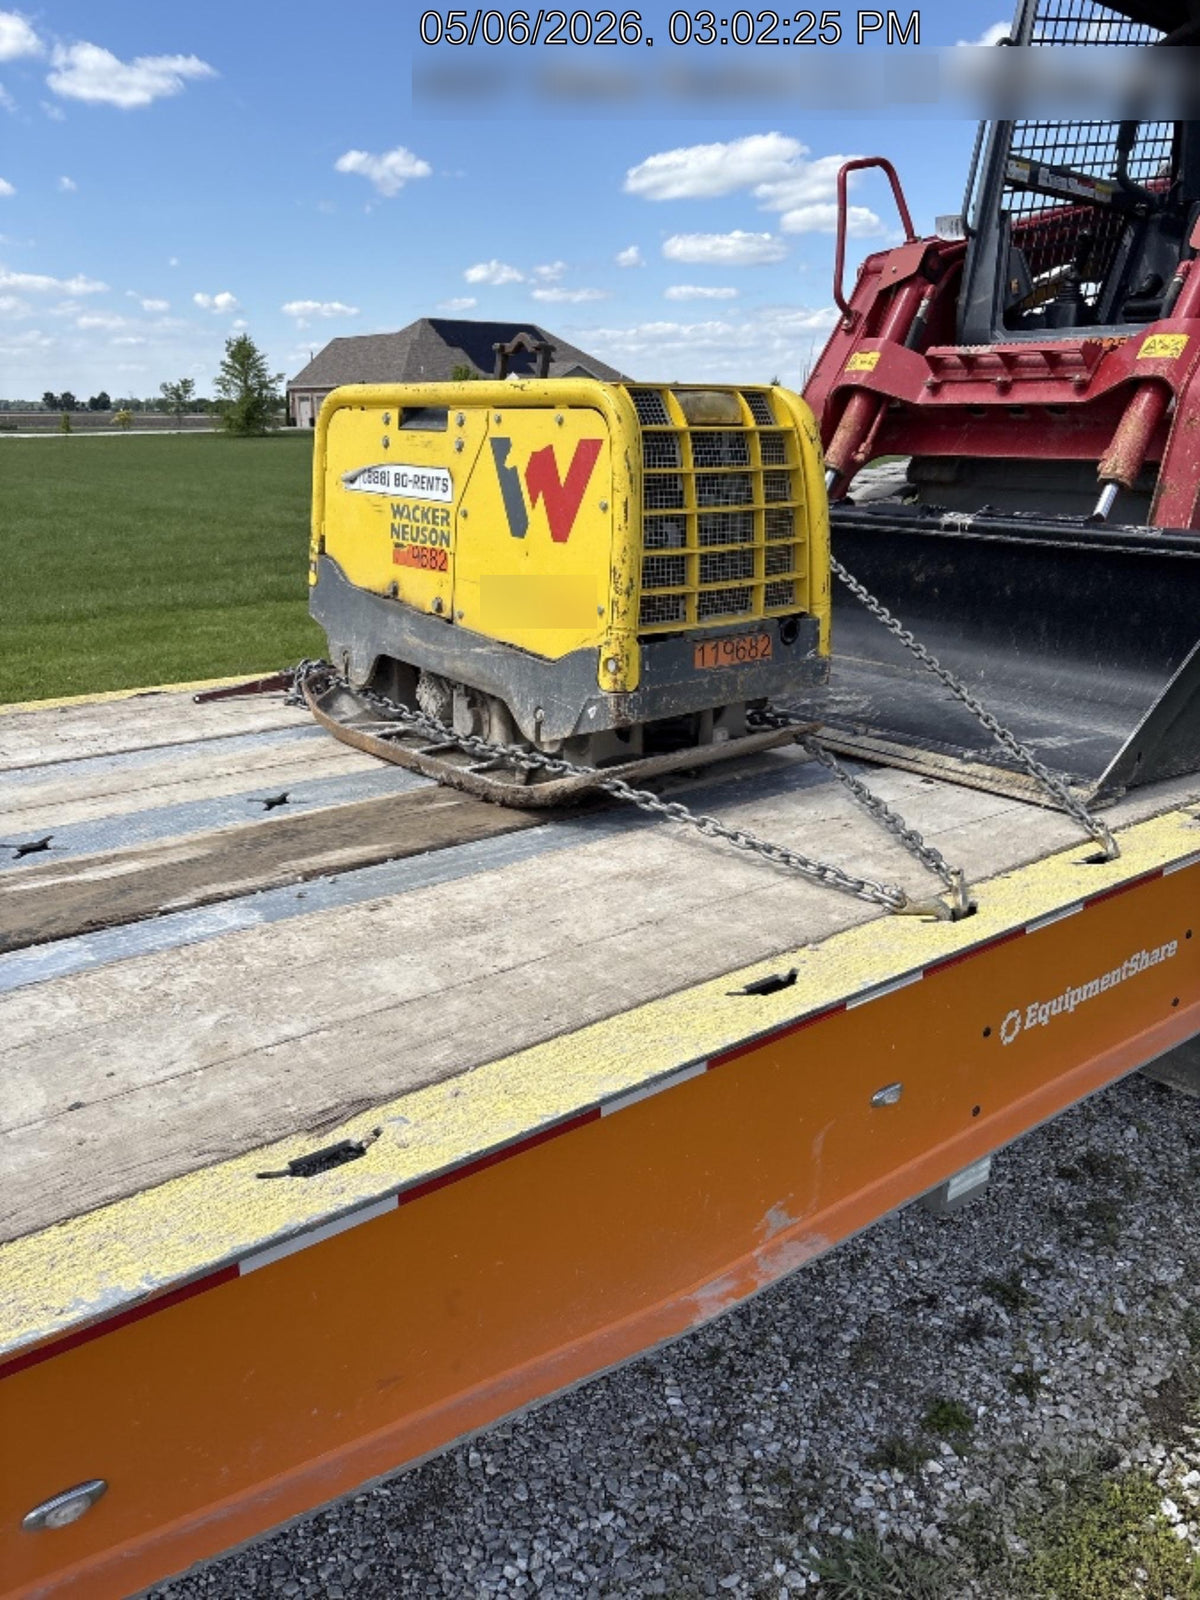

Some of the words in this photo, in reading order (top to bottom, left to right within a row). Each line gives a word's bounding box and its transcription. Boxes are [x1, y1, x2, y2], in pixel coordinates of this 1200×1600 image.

[390, 503, 451, 527] WACKER
[390, 523, 451, 548] NEUSON
[697, 632, 771, 668] 119682
[1023, 940, 1178, 1030] EquipmentShare
